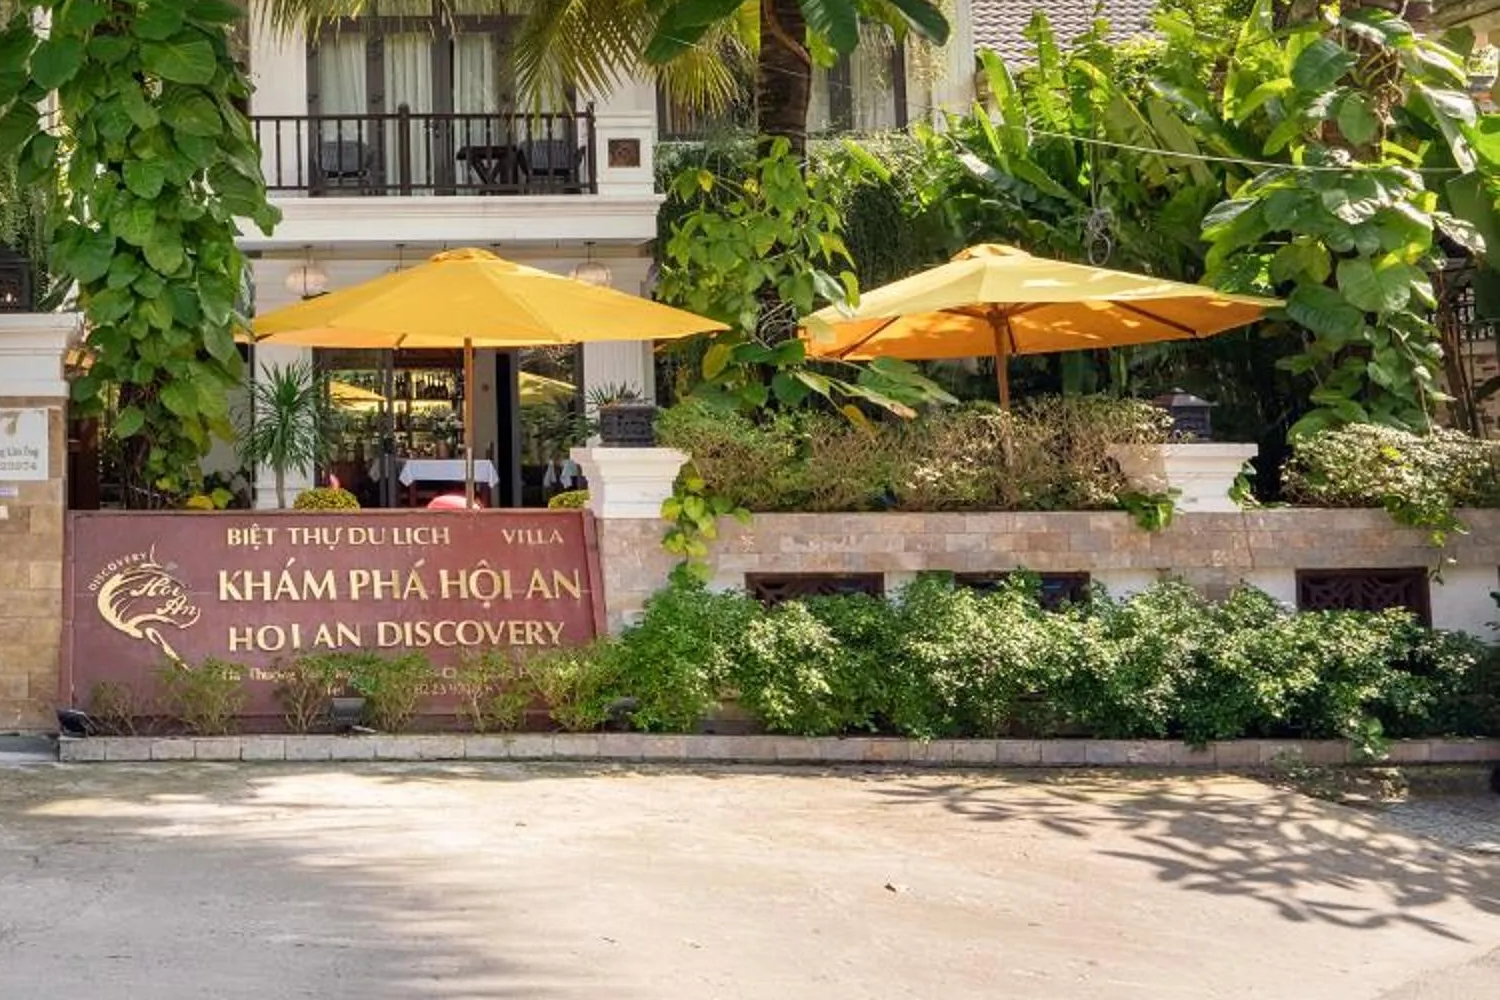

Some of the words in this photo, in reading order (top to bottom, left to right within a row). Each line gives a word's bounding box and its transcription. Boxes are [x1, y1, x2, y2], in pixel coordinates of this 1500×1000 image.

[227, 522, 277, 551] BIỆT
[287, 526, 343, 551] THỰ
[348, 526, 386, 546] DU
[500, 528, 565, 545] VILLA
[88, 551, 148, 591] DISCOVERY
[218, 556, 338, 602] KHÁM
[349, 557, 430, 602] PHÁ
[438, 558, 513, 610] HỘI
[525, 567, 582, 602] AN
[155, 593, 198, 616] An
[229, 622, 302, 652] HOI
[312, 620, 362, 649] AN
[377, 618, 565, 648] DISCOVERY
